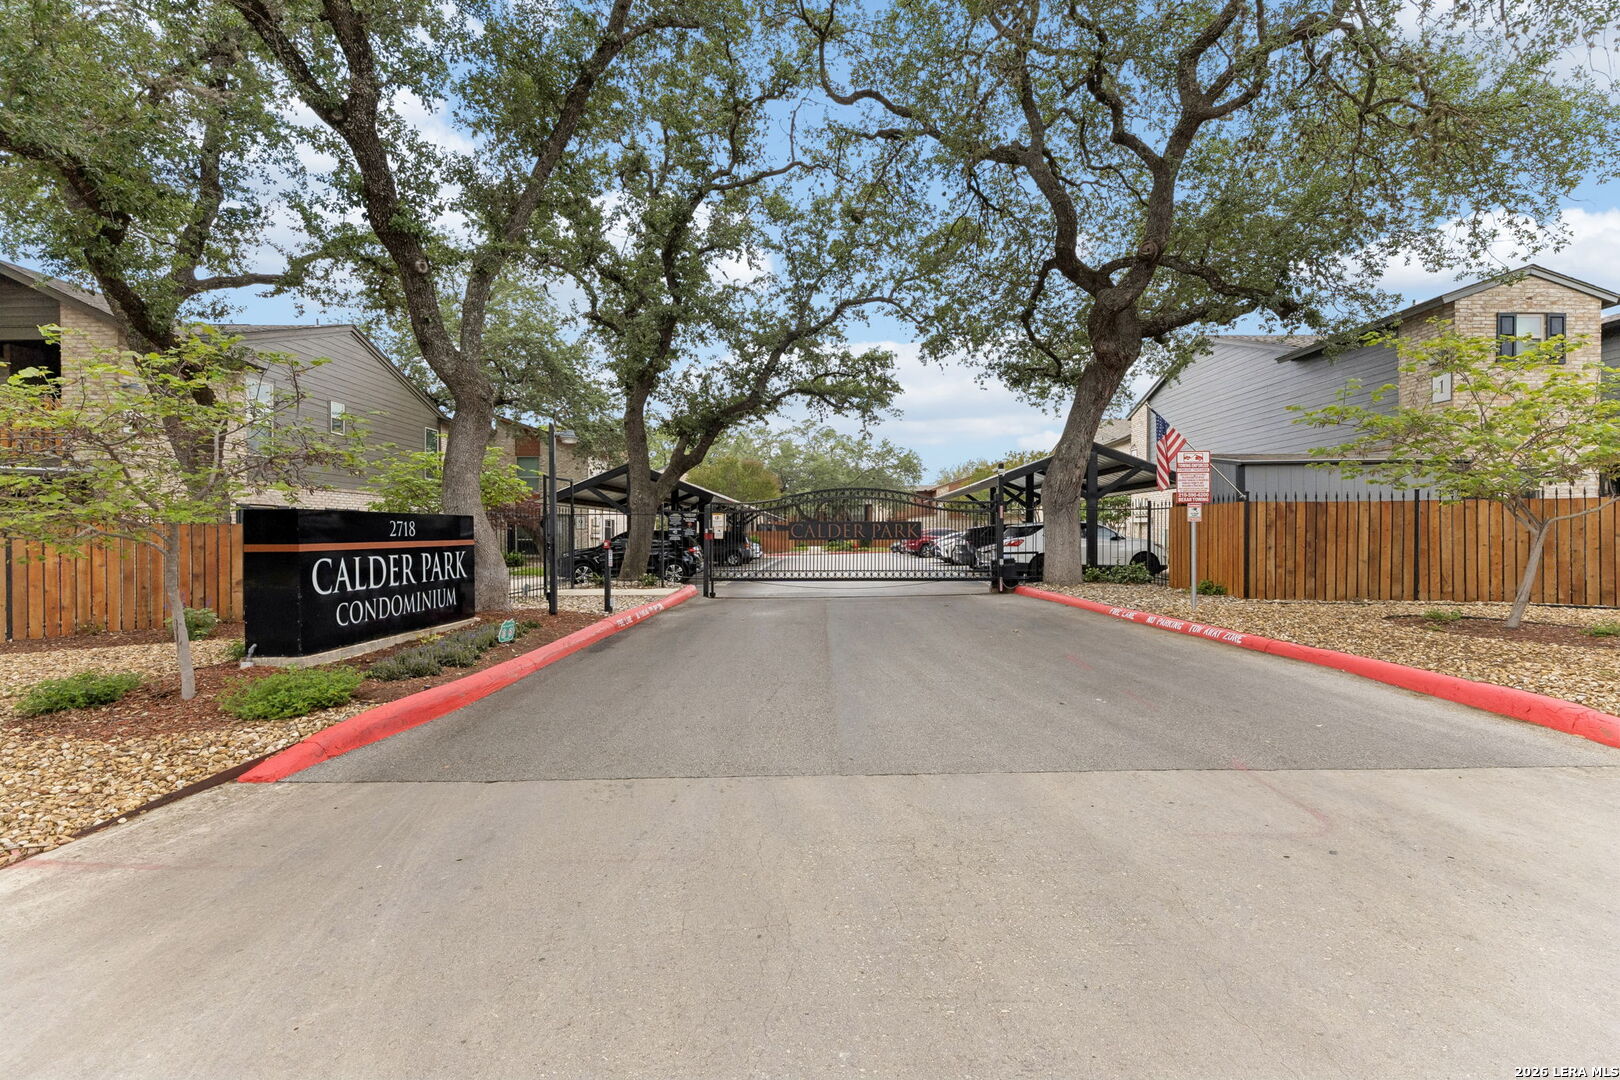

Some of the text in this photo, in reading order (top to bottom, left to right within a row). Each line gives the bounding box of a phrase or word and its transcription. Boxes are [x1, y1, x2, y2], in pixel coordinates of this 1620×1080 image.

[389, 520, 416, 537] 2718
[790, 523, 918, 538] CALDER PARK
[311, 550, 468, 595] CALDER PARK
[335, 586, 457, 626] CONDOMINIUM
[1156, 618, 1184, 629] PARKING
[1223, 632, 1246, 643] ZONE
